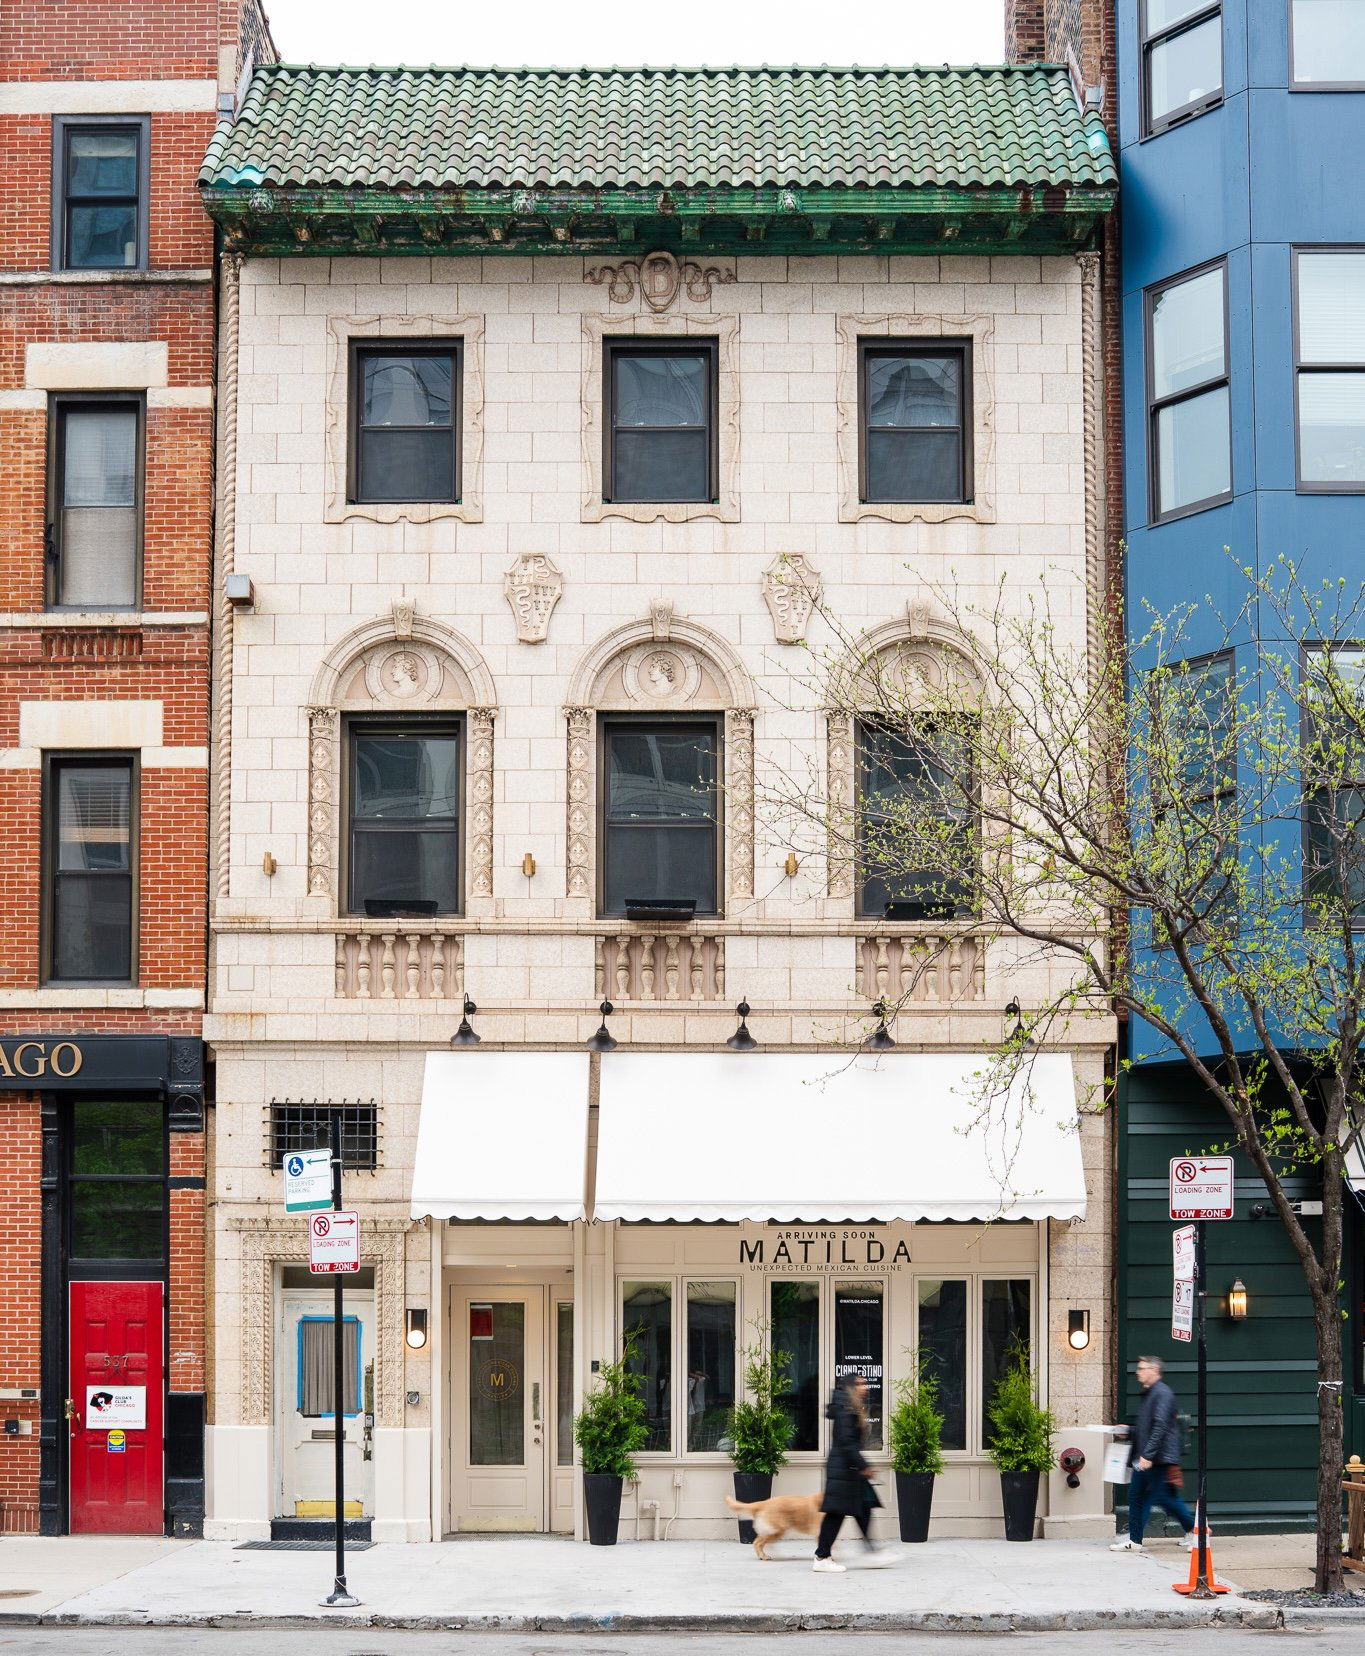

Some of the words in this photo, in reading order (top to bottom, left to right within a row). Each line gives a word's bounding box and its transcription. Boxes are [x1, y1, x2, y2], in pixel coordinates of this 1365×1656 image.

[1174, 1186, 1203, 1194] LOADING
[1174, 1209, 1196, 1218] TOW
[1200, 1209, 1227, 1218] ZONE
[777, 1231, 836, 1239] ARRIVING
[843, 1231, 876, 1239] SOON
[739, 1240, 912, 1263] MATILDA
[313, 1263, 331, 1271] TOW
[333, 1262, 355, 1271] ZONE
[750, 1264, 813, 1272] UNEXPECTED
[816, 1264, 859, 1272] MEXICAN
[863, 1264, 903, 1272] CUISINE
[103, 1355, 129, 1367] 537
[490, 1373, 504, 1387] M
